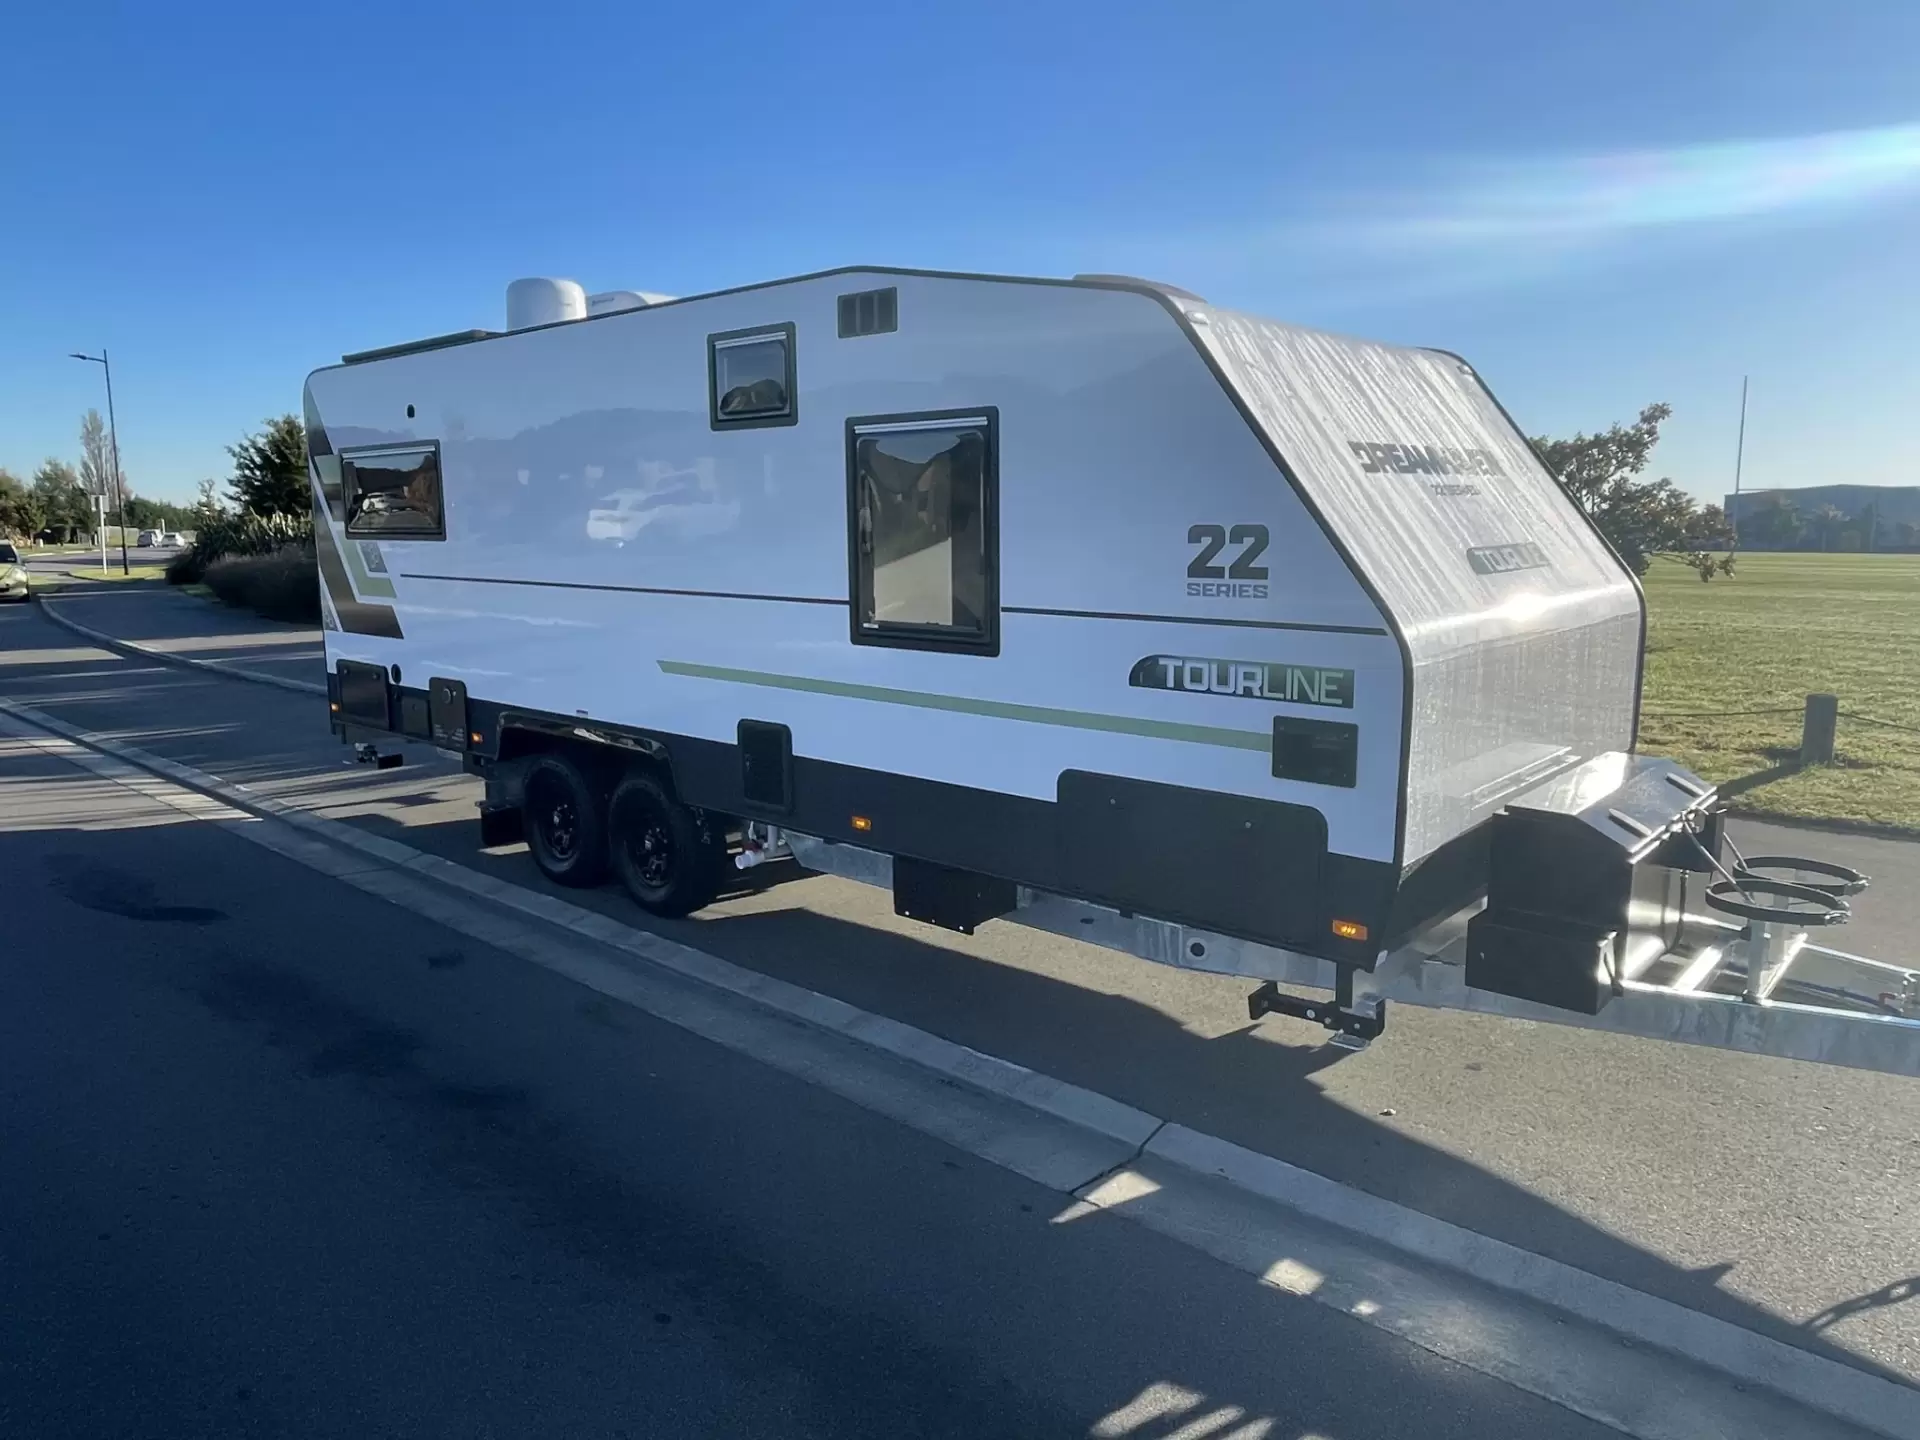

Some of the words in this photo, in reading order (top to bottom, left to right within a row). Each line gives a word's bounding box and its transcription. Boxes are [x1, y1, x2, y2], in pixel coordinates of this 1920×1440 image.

[1187, 524, 1269, 580] 22
[1187, 582, 1268, 599] SERIES
[1157, 657, 1344, 704] TOURLINE
